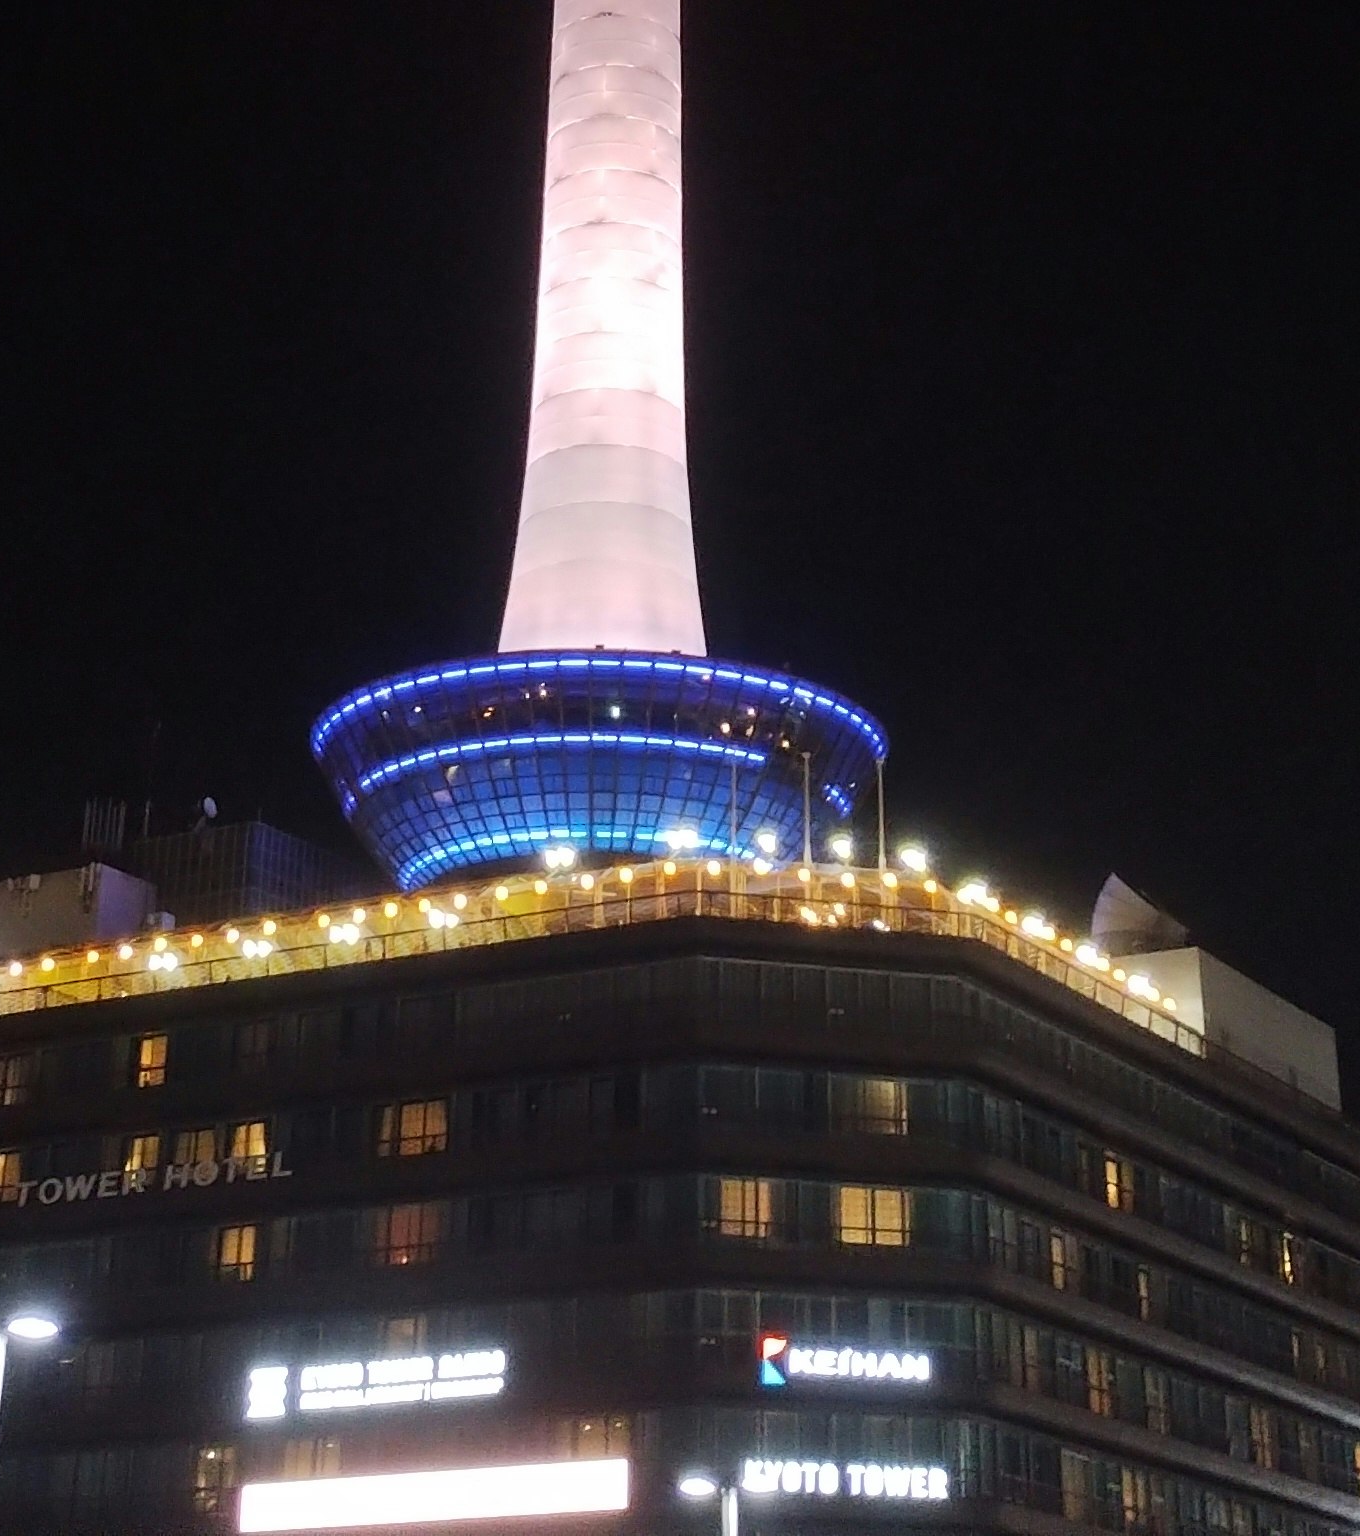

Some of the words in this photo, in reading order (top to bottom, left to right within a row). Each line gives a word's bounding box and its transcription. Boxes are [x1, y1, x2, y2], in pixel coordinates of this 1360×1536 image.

[15, 1166, 147, 1208] TOWER
[163, 1151, 293, 1191] HOTEL
[788, 1347, 931, 1380] KEIHAN
[743, 1460, 839, 1494] KYOTO
[847, 1464, 948, 1499] TOWER
